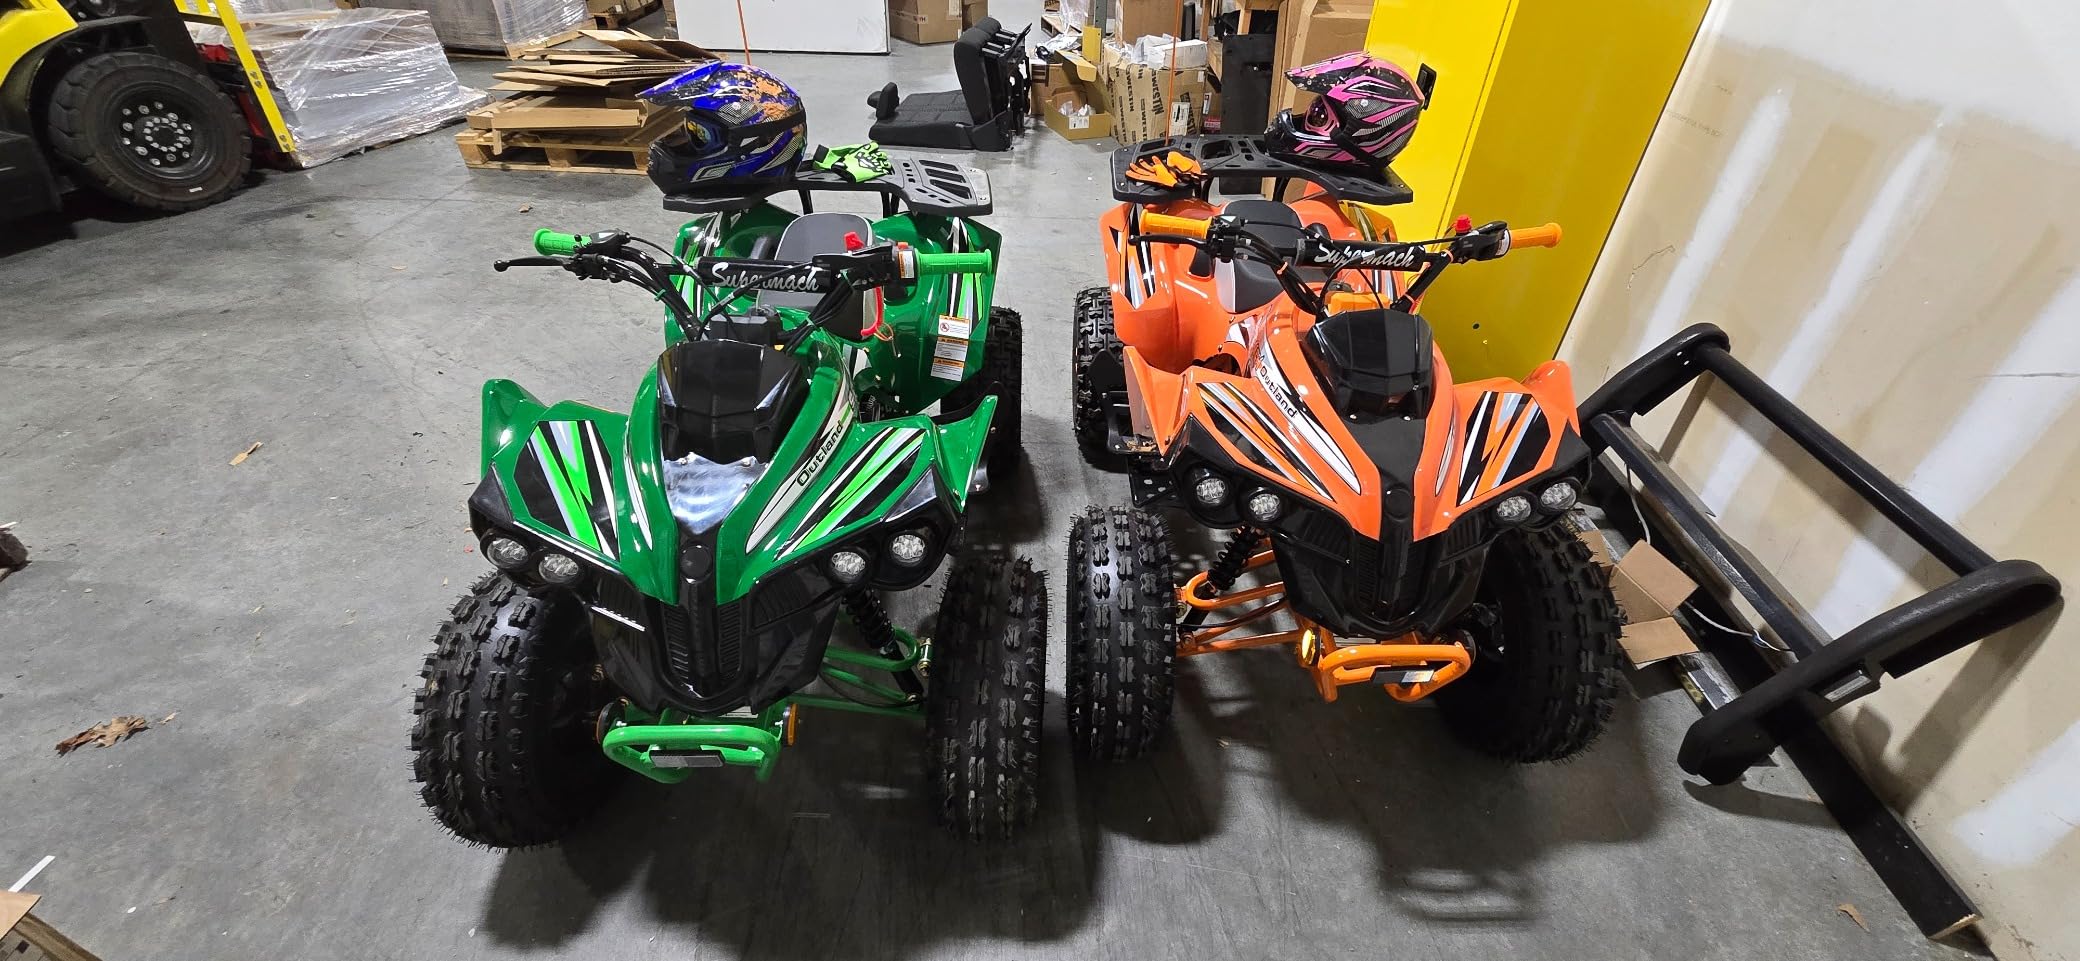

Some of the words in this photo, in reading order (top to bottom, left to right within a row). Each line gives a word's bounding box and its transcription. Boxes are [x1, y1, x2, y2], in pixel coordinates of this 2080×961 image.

[1151, 75, 1165, 115] WESTIN
[1260, 366, 1298, 418] Outland
[796, 420, 844, 487] Outland
